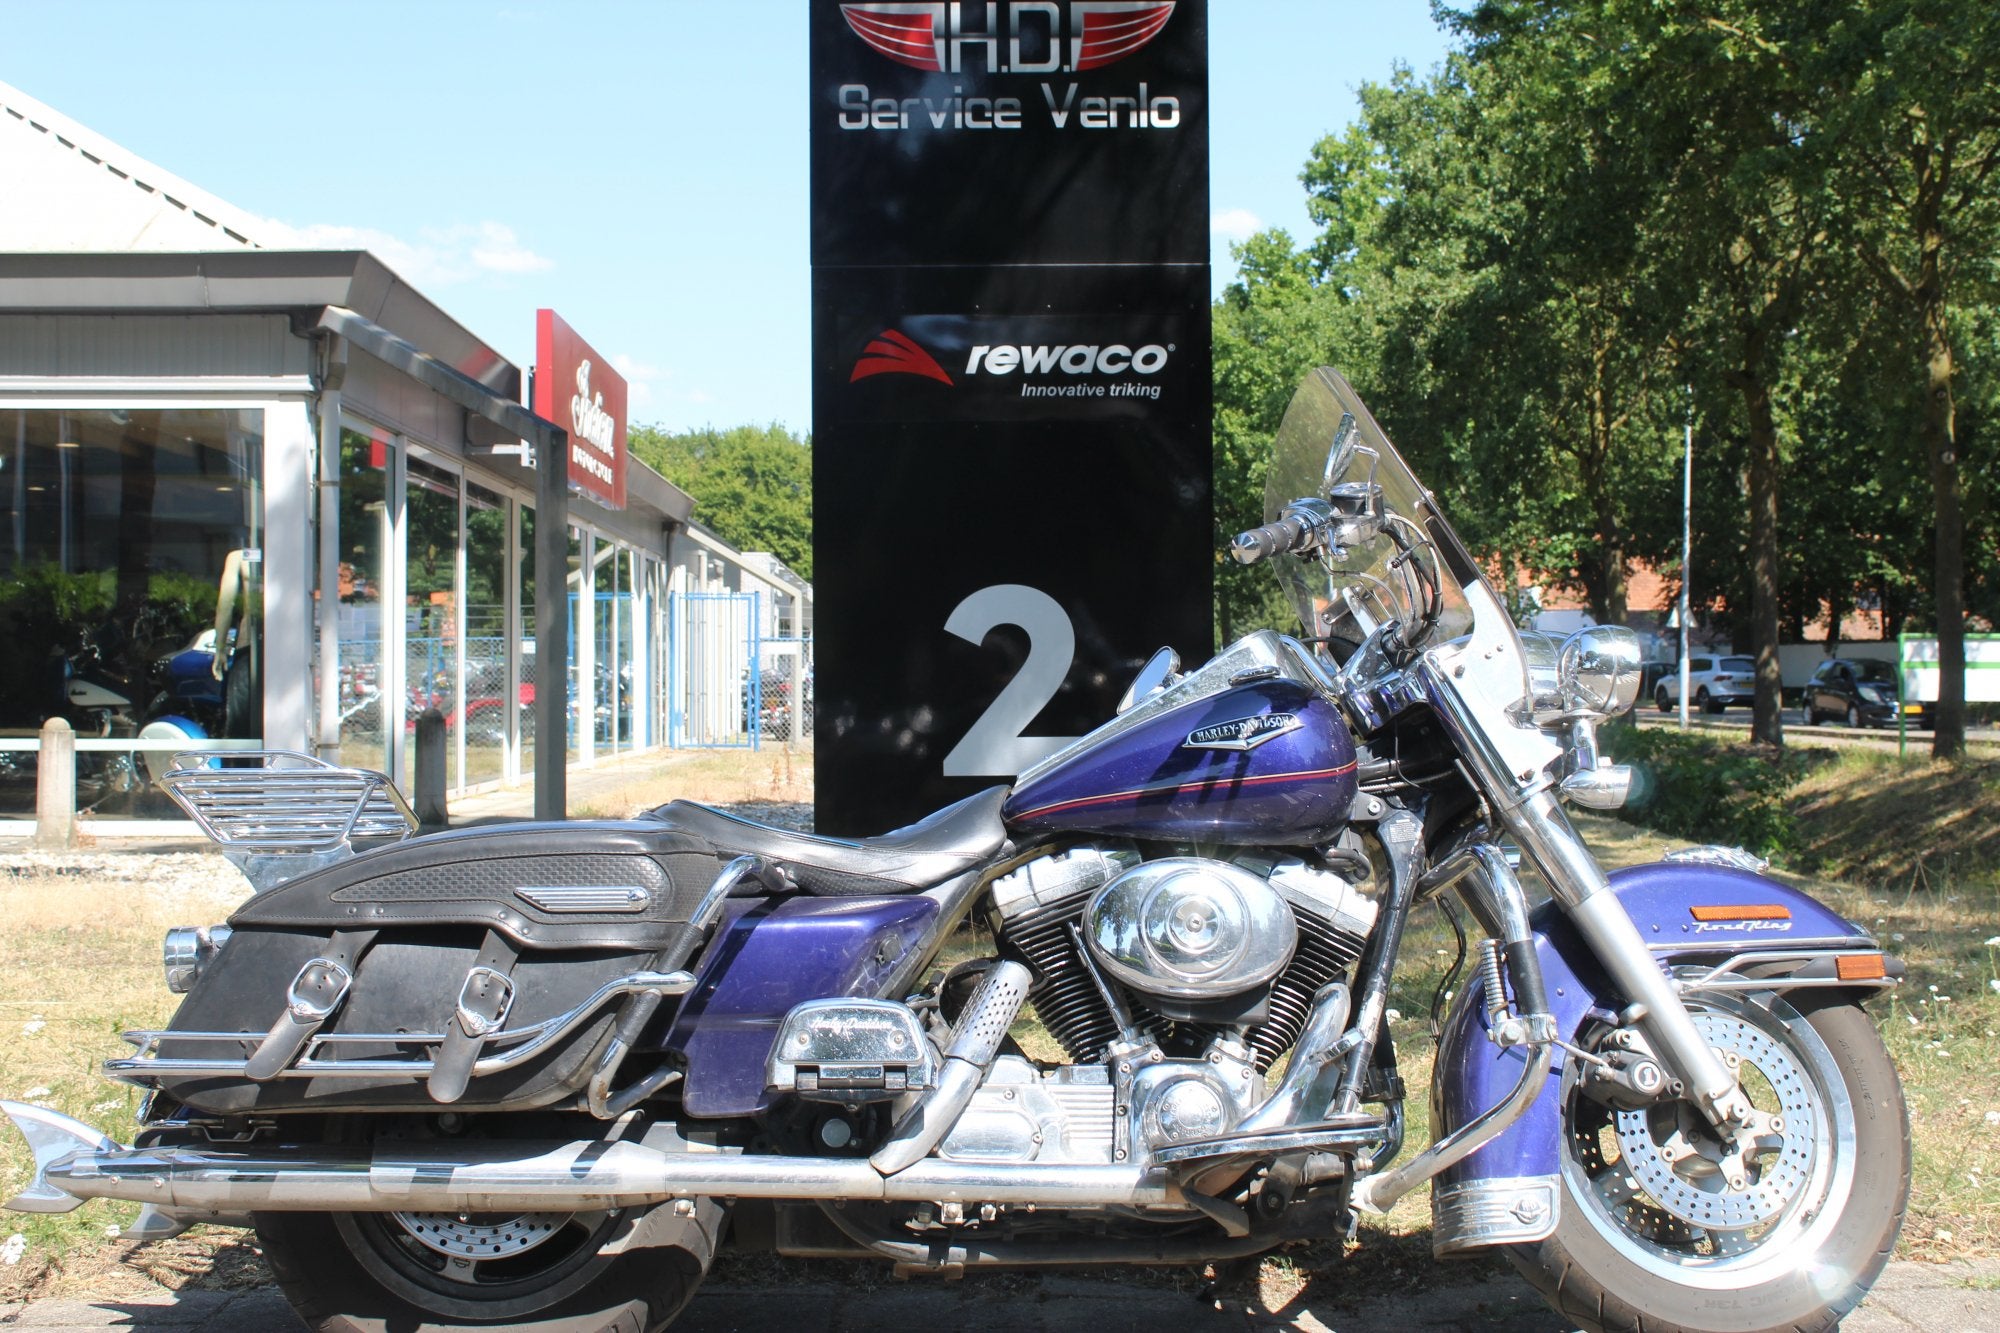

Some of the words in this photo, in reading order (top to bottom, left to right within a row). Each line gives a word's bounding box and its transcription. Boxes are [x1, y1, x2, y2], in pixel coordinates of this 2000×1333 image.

[838, 84, 1022, 130] Service
[1041, 82, 1181, 129] Venlo
[1021, 383, 1105, 398] Innovative
[1109, 383, 1161, 399] triking
[943, 584, 1084, 776] 2
